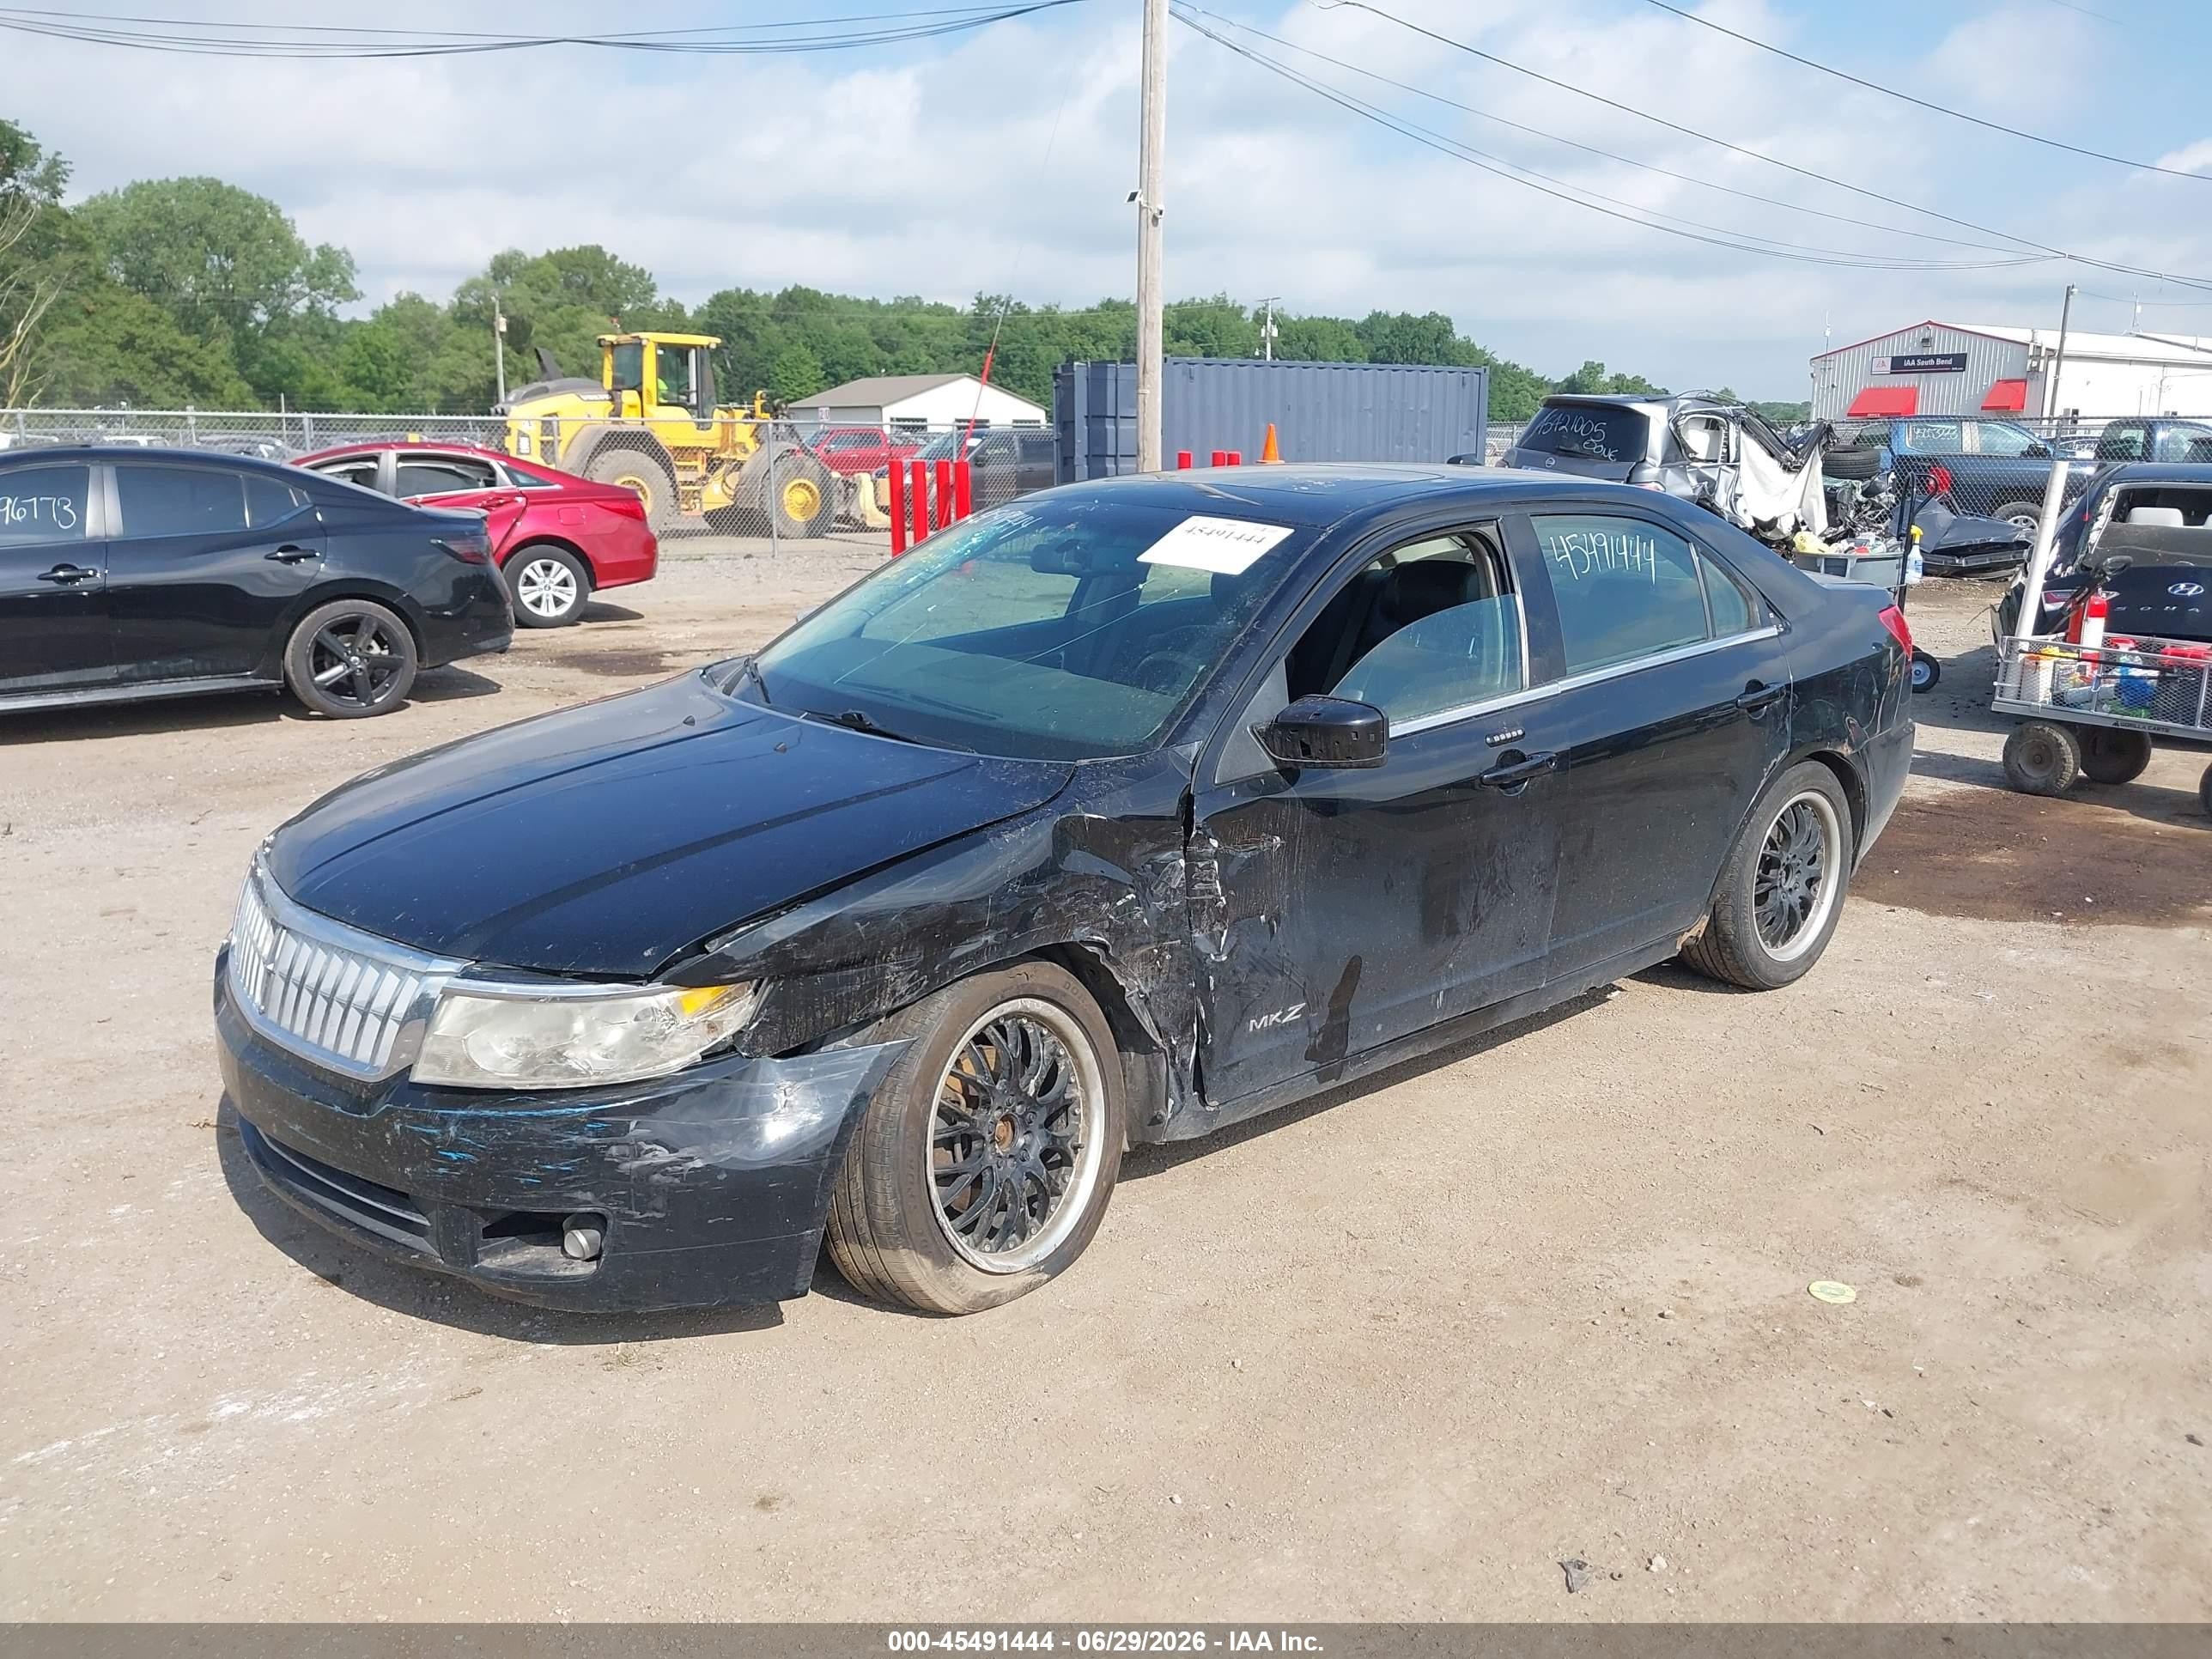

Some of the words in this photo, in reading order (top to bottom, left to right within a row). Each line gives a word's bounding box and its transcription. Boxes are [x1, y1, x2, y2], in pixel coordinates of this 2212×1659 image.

[1917, 358, 1935, 367] South
[1936, 357, 1953, 366] Bend
[1550, 532, 1656, 586] 45491444
[1249, 1002, 1307, 1032] MKZ
